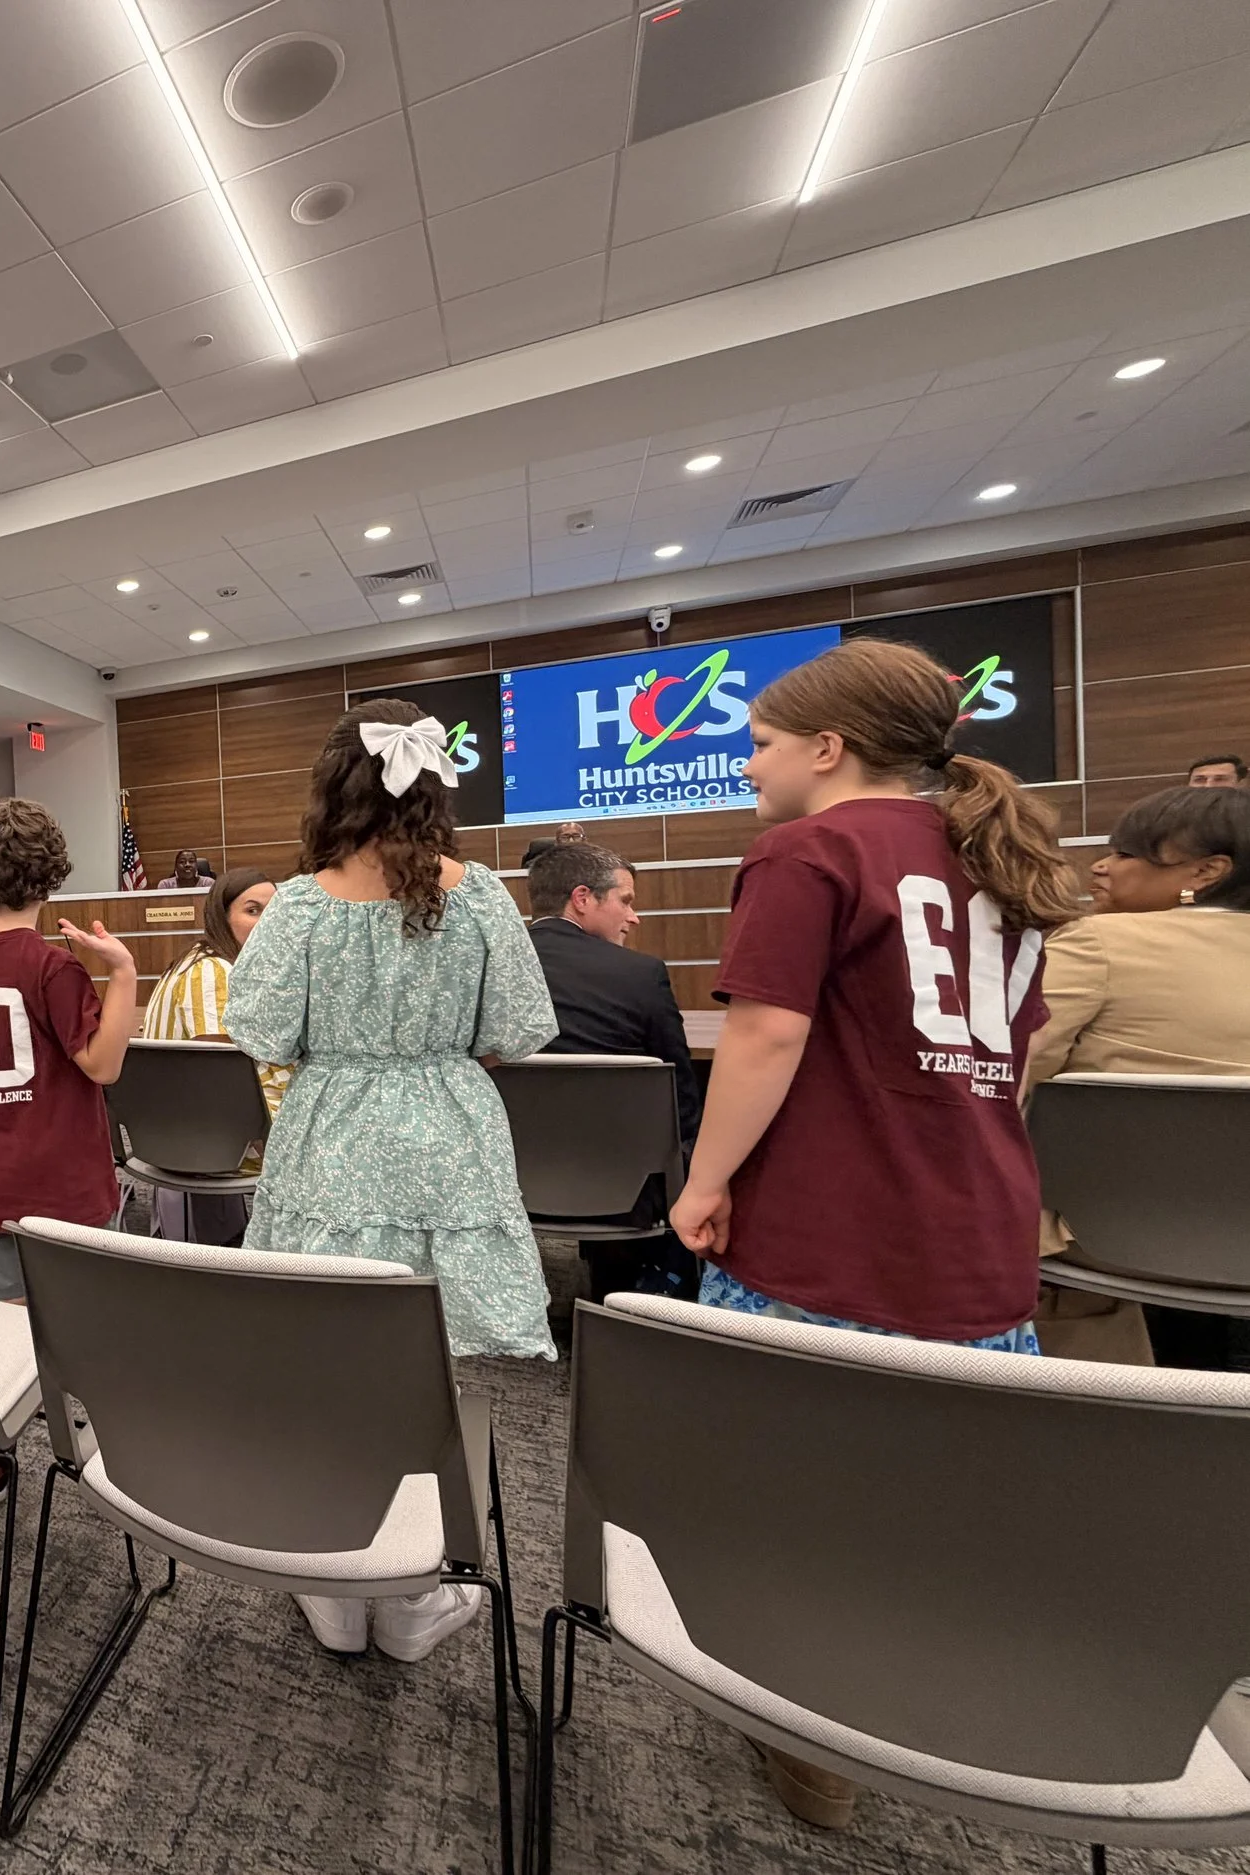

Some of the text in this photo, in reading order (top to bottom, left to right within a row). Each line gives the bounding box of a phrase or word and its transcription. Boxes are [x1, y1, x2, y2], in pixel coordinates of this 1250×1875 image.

[576, 670, 750, 749] HCS
[579, 753, 749, 791] Huntsville
[579, 780, 751, 808] CITY SCHOOLS
[916, 1051, 971, 1075] YEARS
